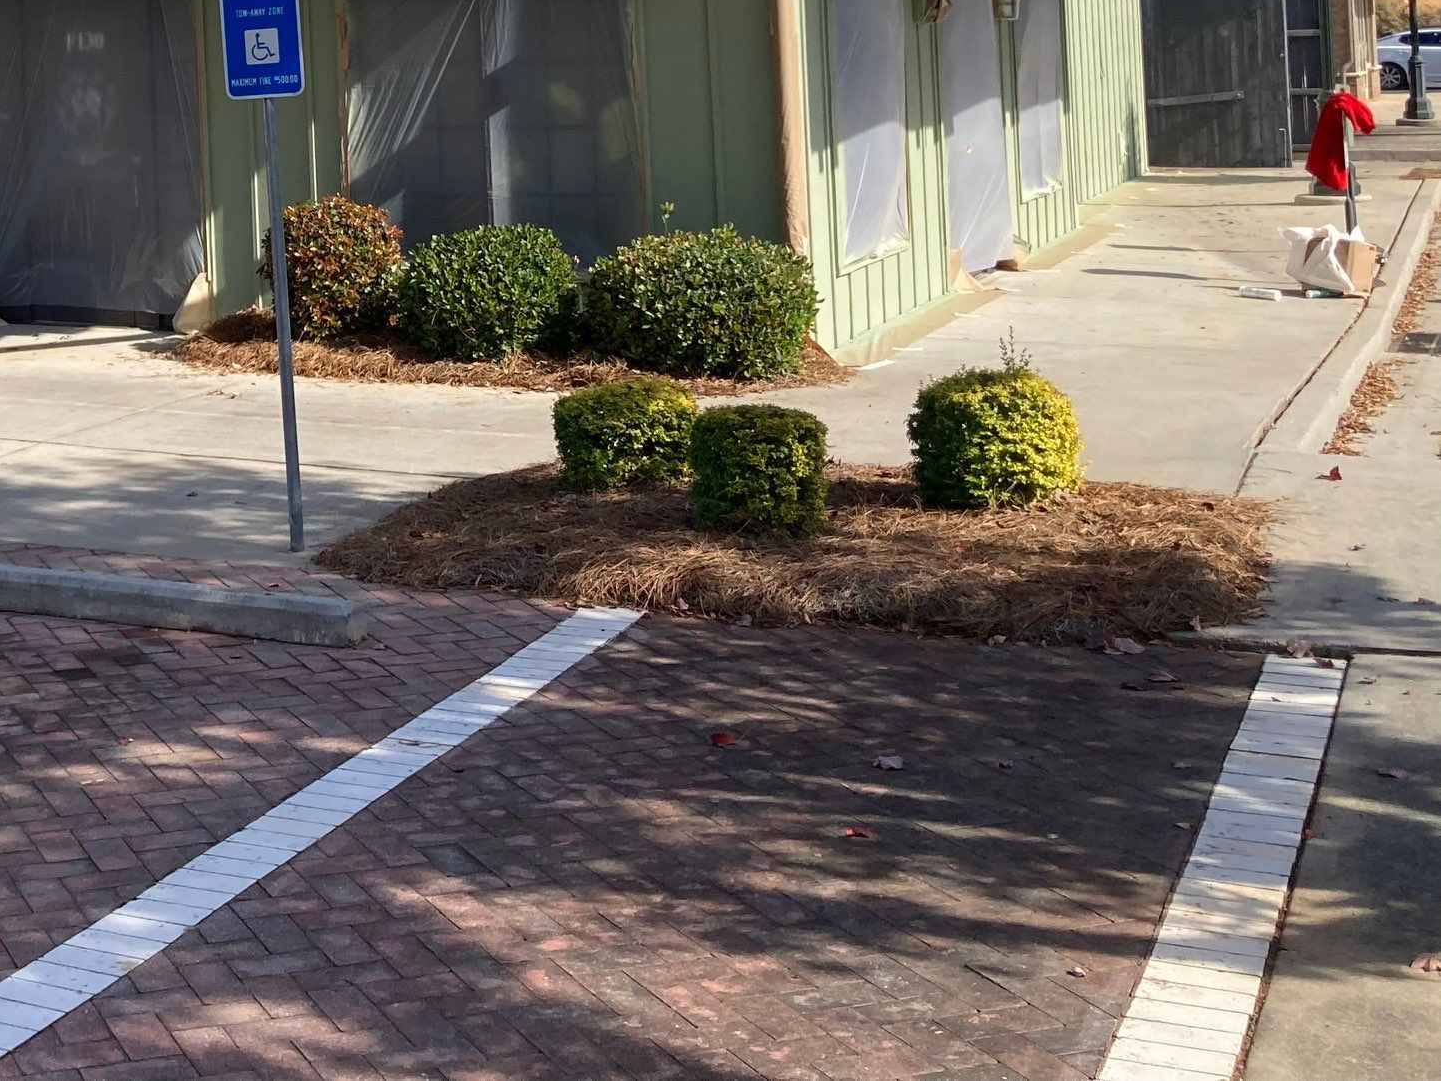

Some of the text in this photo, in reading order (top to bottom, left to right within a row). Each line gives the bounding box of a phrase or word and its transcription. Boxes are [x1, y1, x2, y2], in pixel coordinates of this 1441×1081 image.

[236, 6, 284, 18] TOW-AWAY ZONE
[231, 78, 257, 87] MAXIMUM
[259, 77, 271, 86] FINE
